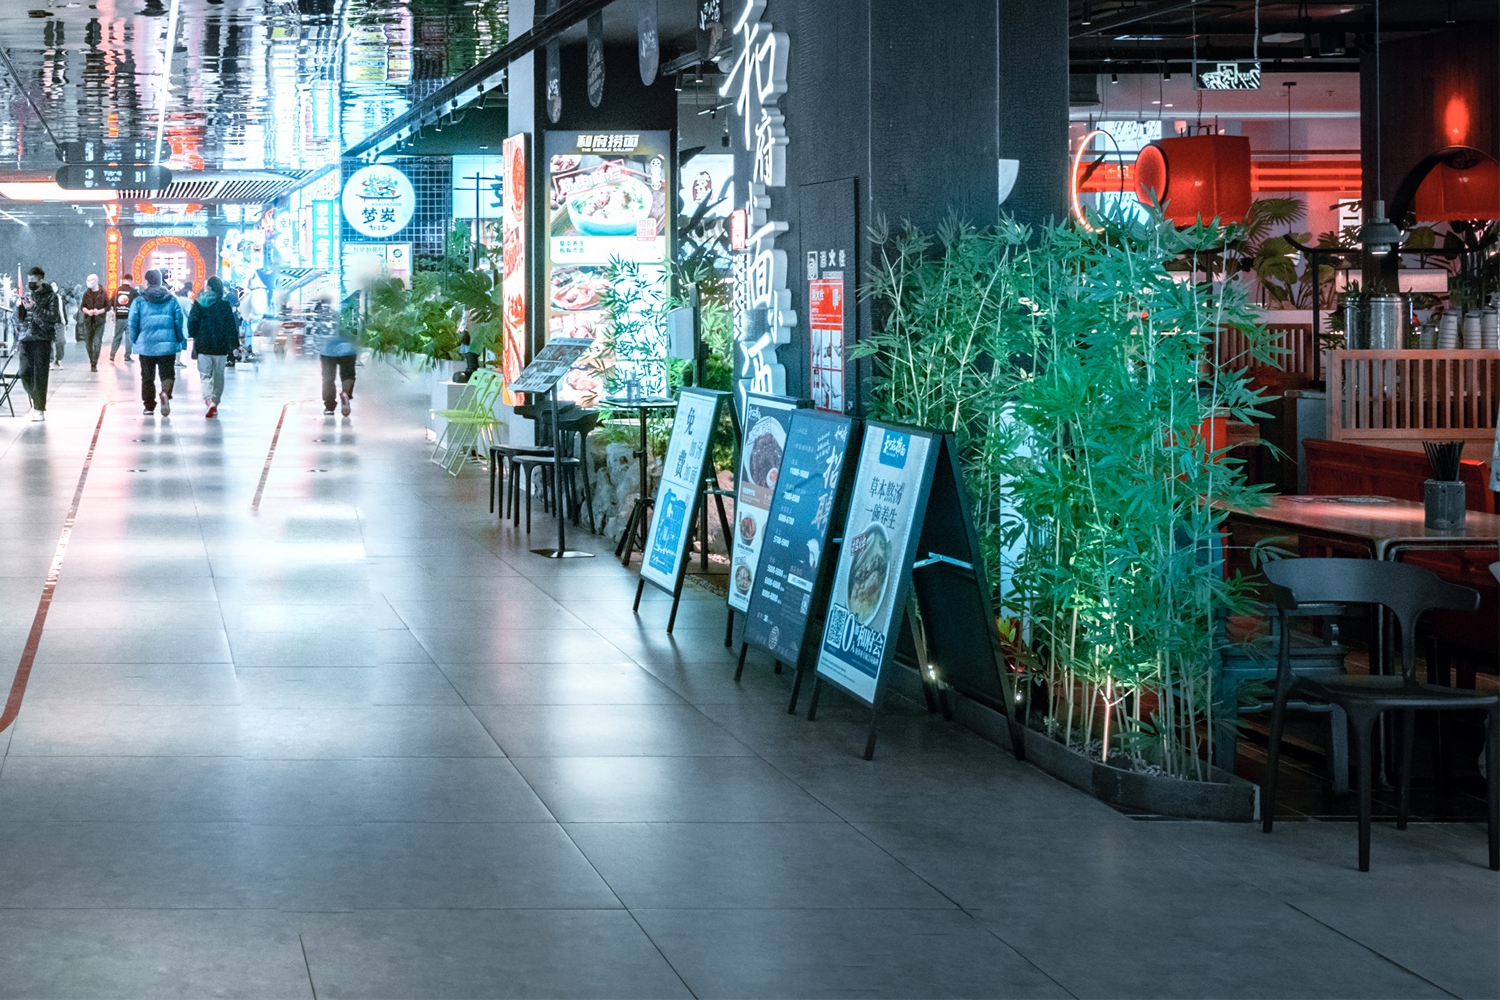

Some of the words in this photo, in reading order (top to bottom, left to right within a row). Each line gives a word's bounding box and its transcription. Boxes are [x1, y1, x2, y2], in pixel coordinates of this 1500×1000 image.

[576, 134, 640, 149] 和府捞面
[361, 207, 396, 224] 梦炭
[157, 236, 185, 246] TATTOO
[819, 249, 846, 268] 消火栓
[868, 476, 905, 506] 草本熬汤
